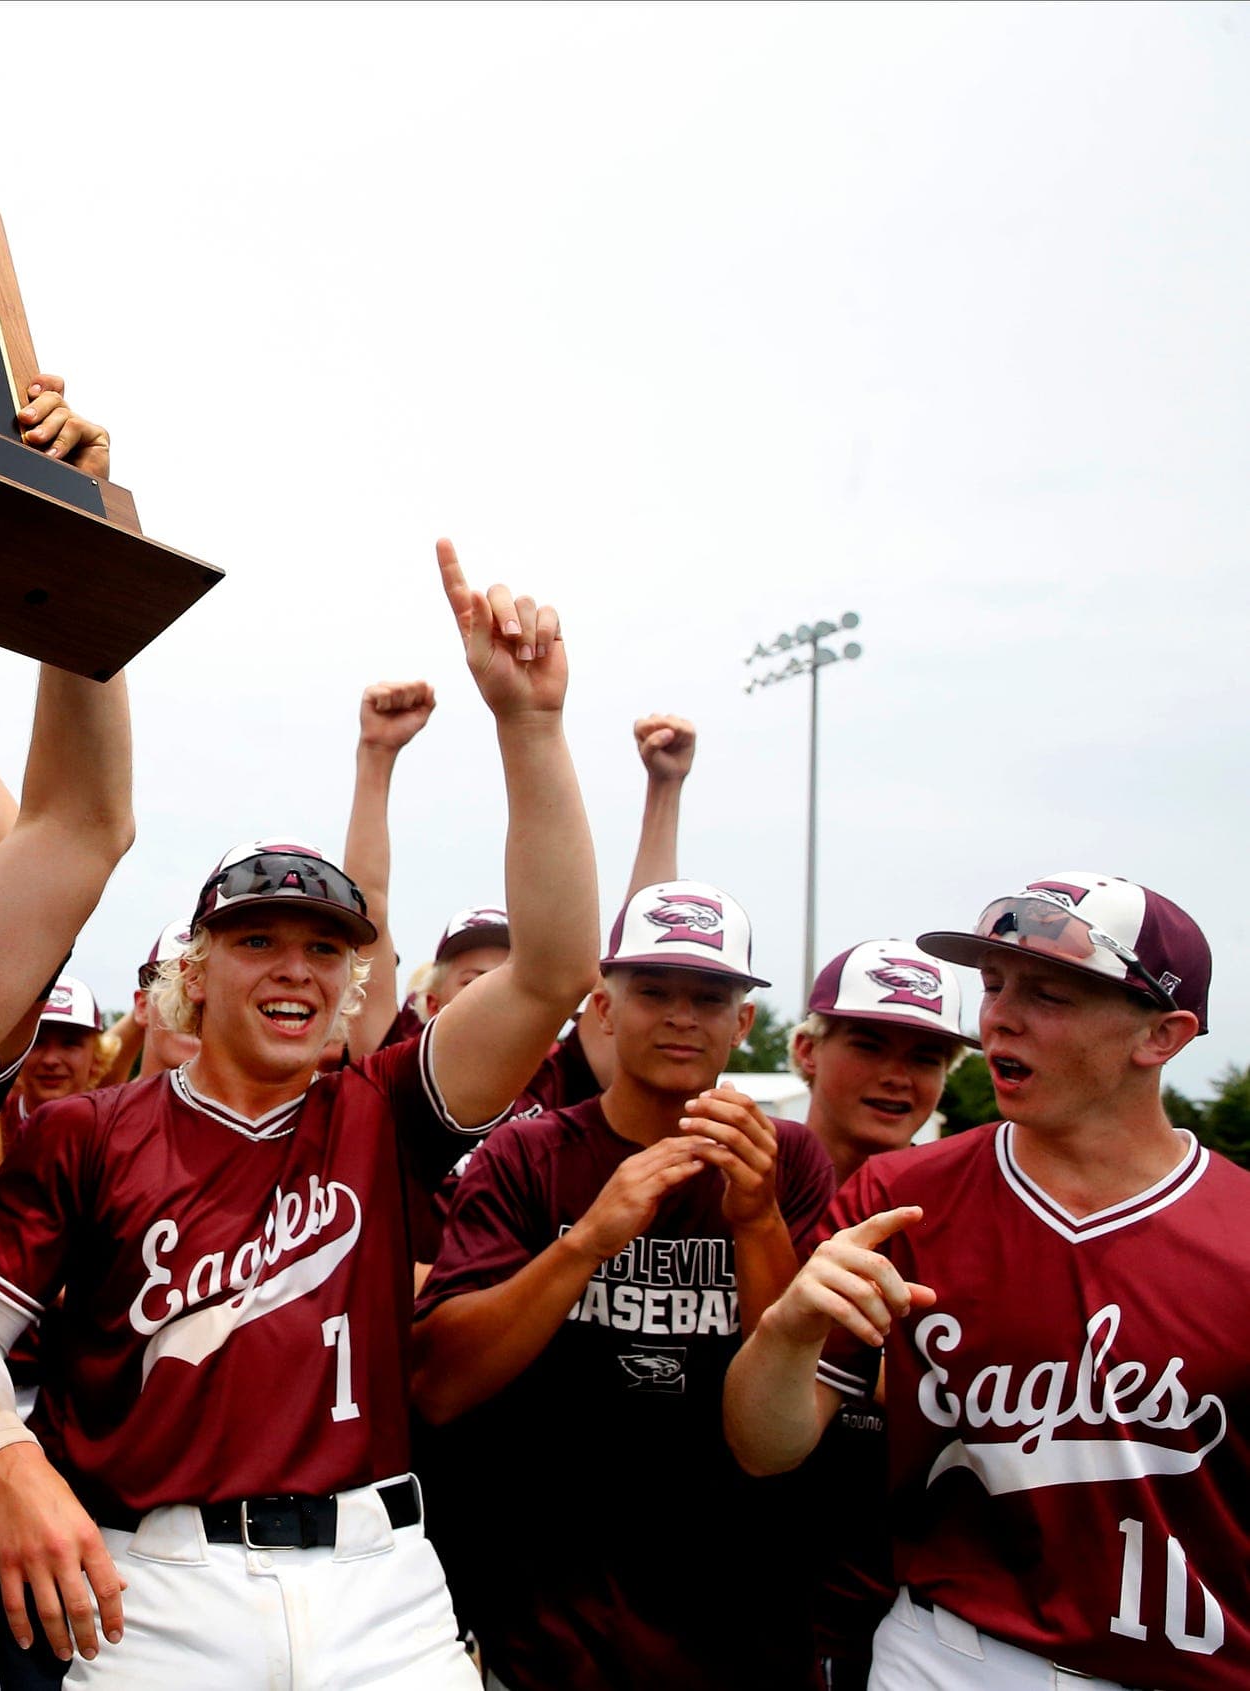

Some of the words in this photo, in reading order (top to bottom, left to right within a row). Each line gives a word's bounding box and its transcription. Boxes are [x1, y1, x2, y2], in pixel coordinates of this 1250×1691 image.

[129, 1175, 361, 1336] Eagles
[565, 1280, 743, 1336] ASEBAL
[915, 1303, 1227, 1455] Eagles
[1110, 1517, 1225, 1655] 10
